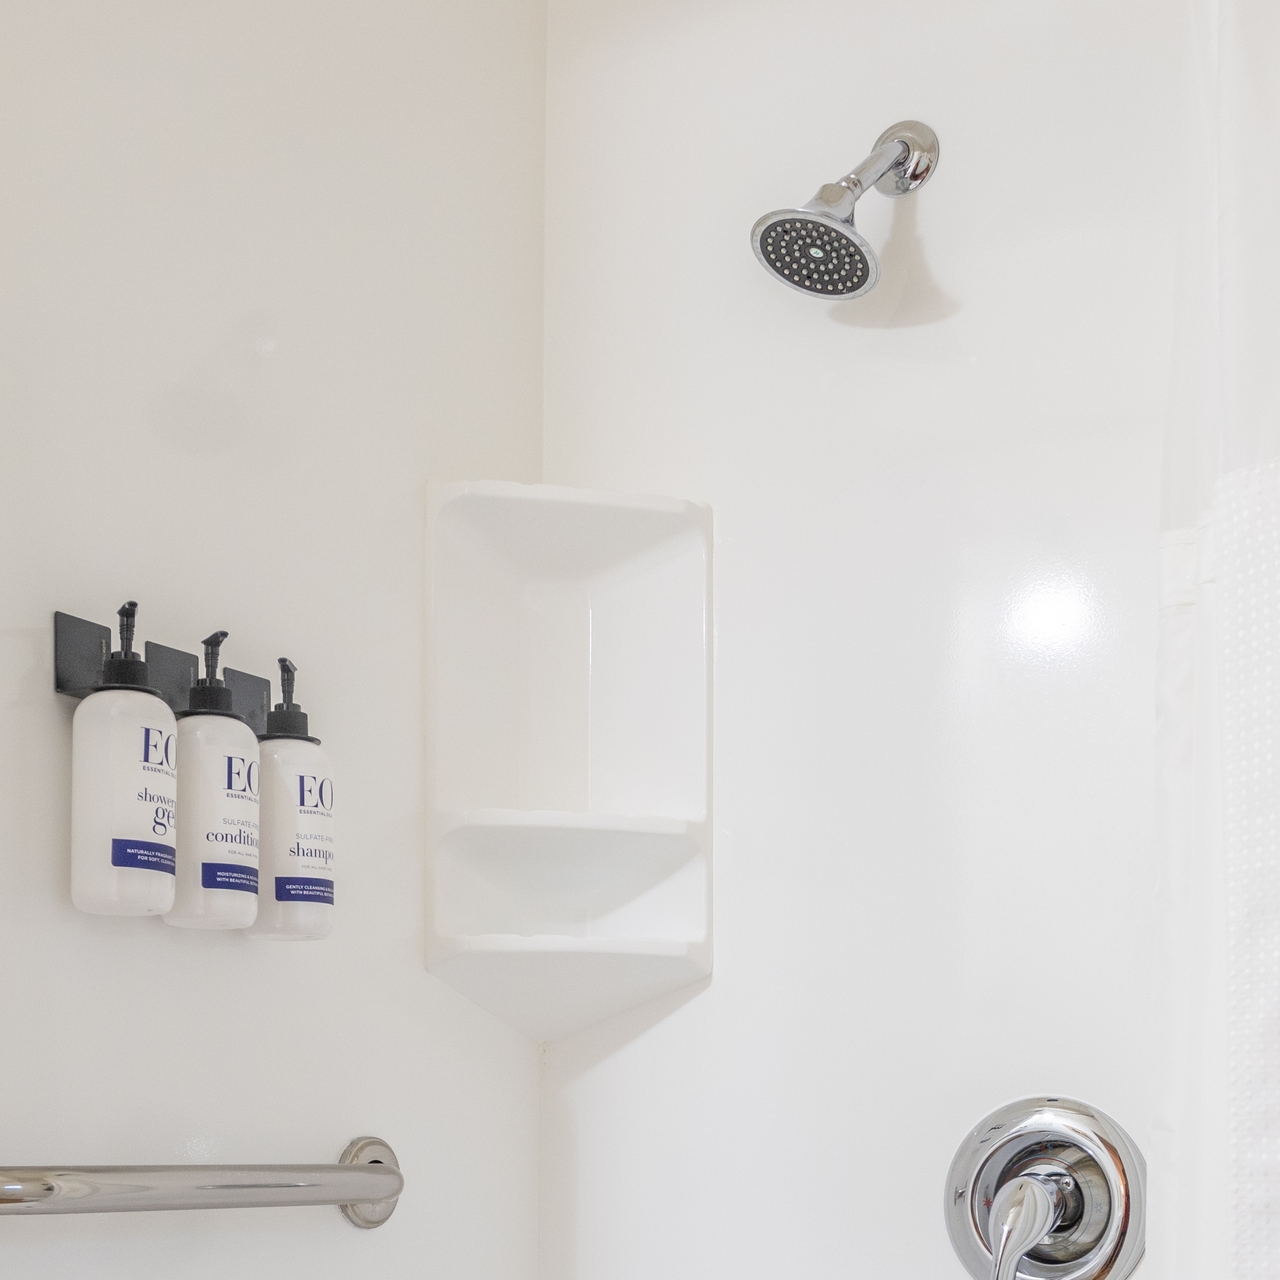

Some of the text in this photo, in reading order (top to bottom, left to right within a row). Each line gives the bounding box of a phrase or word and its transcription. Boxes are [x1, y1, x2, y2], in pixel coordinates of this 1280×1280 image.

[139, 726, 177, 771] EO
[223, 755, 259, 796] EO
[136, 787, 176, 808] shower
[295, 774, 334, 811] EO
[206, 828, 259, 849] conditio
[126, 848, 155, 856] NATURALLY
[289, 842, 334, 865] shampo
